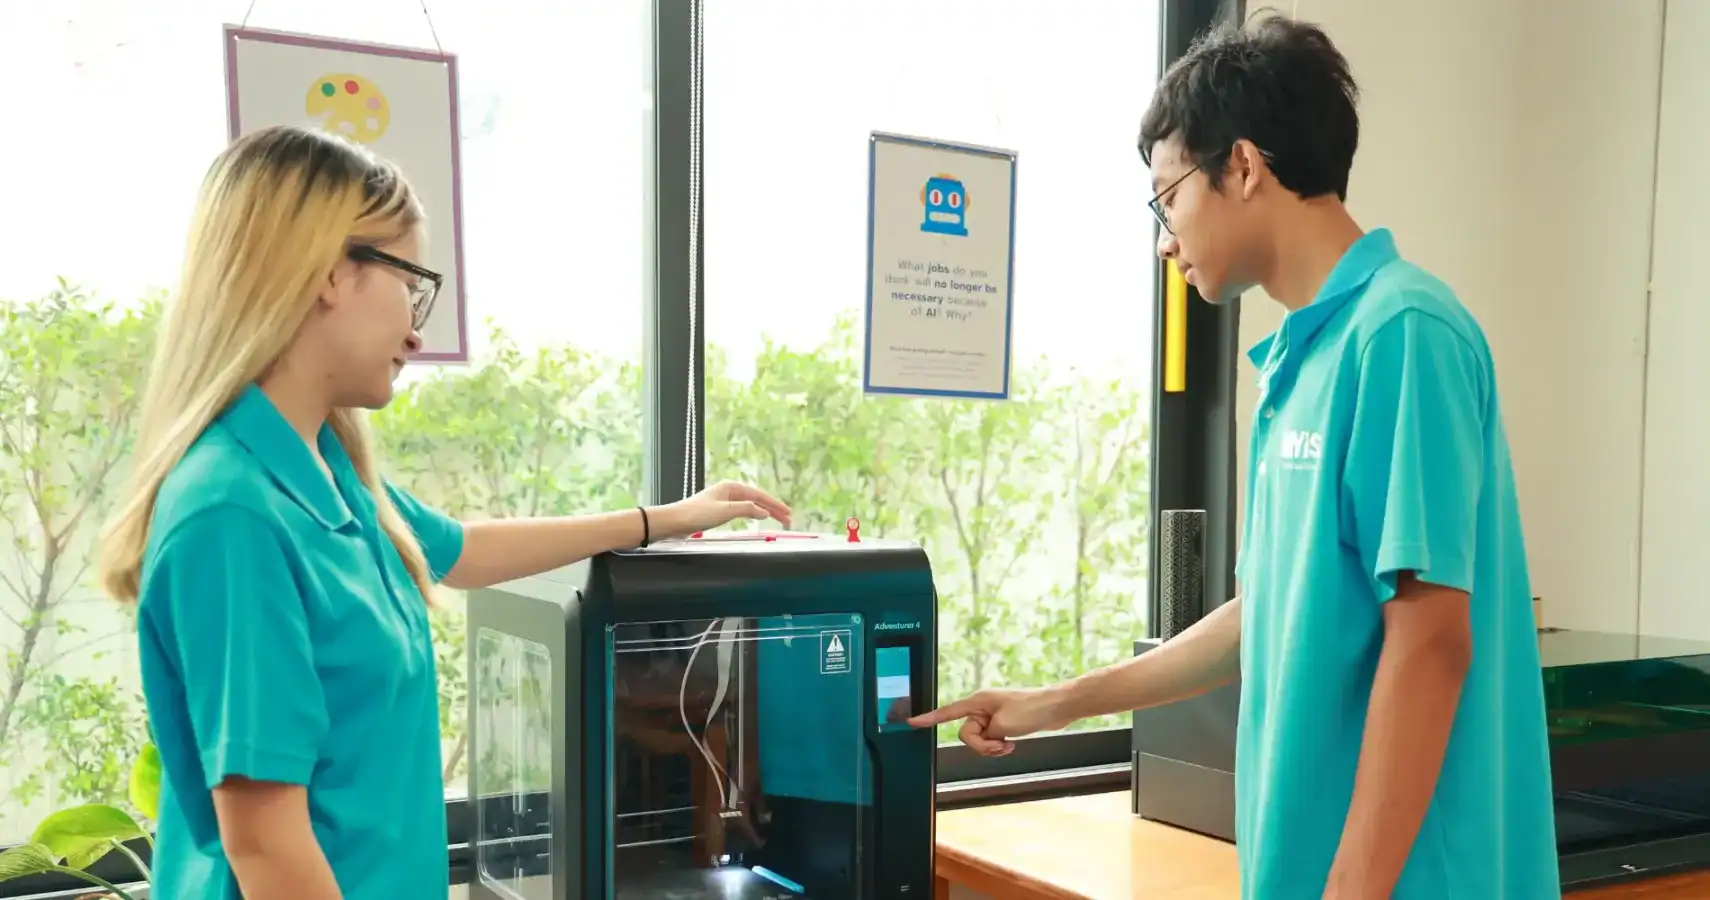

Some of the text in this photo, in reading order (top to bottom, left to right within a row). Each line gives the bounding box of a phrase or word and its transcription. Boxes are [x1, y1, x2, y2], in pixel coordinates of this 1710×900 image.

[898, 260, 924, 271] What
[927, 263, 950, 274] jobs
[953, 265, 966, 275] do
[934, 280, 947, 288] no
[951, 280, 981, 293] longer
[985, 284, 997, 293] be
[891, 292, 943, 304] necessary
[916, 621, 920, 629] 4
